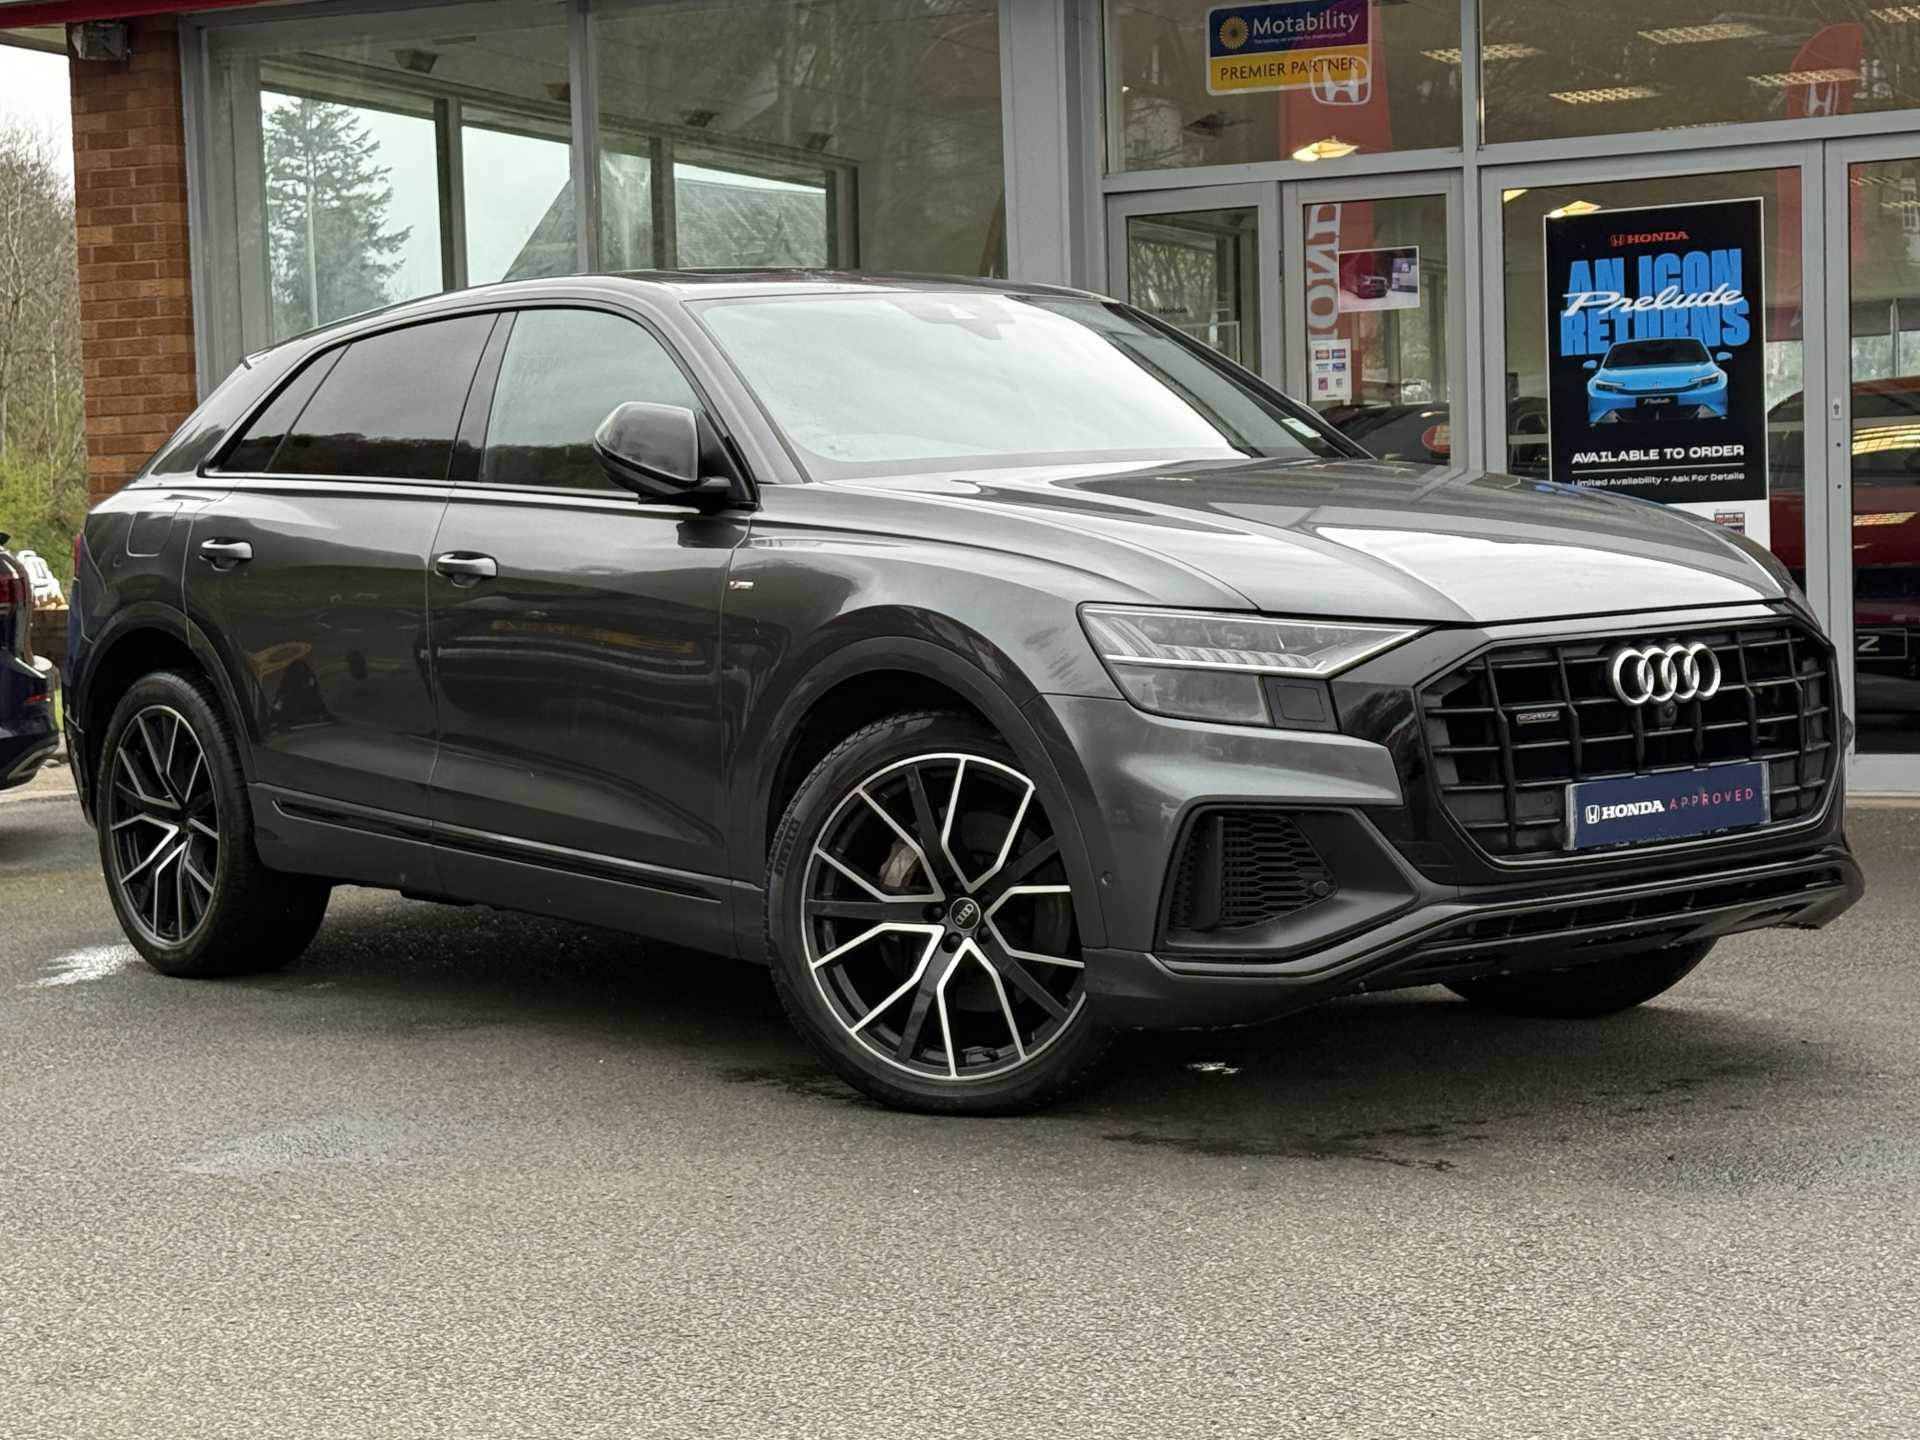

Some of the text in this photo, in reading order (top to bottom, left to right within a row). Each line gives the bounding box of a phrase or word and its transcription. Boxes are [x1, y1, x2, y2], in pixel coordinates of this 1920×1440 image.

[1253, 10, 1360, 36] Motability
[1220, 57, 1359, 81] PREMIER PARTNER
[1626, 230, 1690, 244] HONDA
[1568, 248, 1742, 306] AN ICON
[1562, 282, 1746, 317] Prelude
[1560, 299, 1750, 357] RETURNS
[1571, 445, 1745, 465] AVAILABLE TO ORDER
[1571, 478, 1608, 489] Limited
[1609, 475, 1663, 487] Availability
[1671, 474, 1690, 484] Ask
[1691, 473, 1709, 482] For
[1710, 471, 1745, 481] Details
[1601, 787, 1755, 820] HONDA APPROVED
